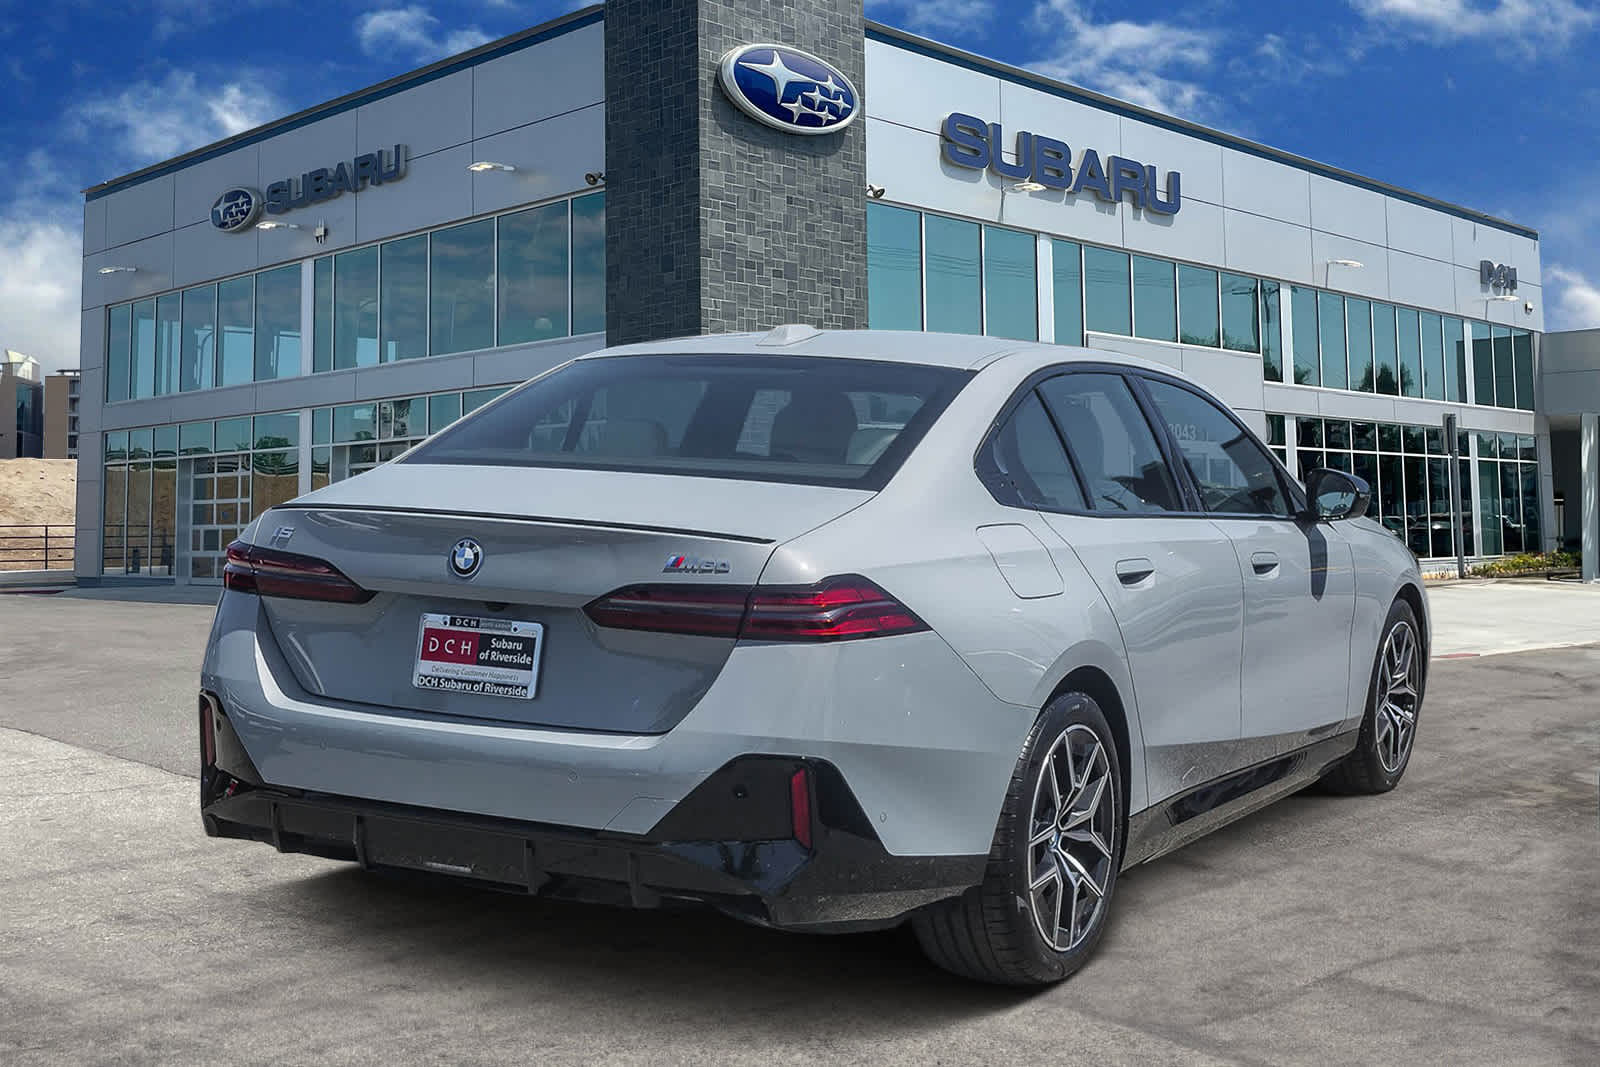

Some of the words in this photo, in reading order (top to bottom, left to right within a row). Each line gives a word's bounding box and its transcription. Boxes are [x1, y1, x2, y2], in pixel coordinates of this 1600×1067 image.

[941, 112, 1181, 215] SUBARU
[266, 144, 407, 214] SUBARU
[455, 618, 477, 627] DCH
[428, 637, 472, 655] DCH
[491, 638, 523, 650] Subaru
[479, 650, 490, 660] of
[490, 651, 532, 665] Riverside
[418, 677, 439, 687] DCH
[439, 678, 472, 690] Subaru
[473, 681, 483, 691] of
[484, 683, 527, 697] Riverside
